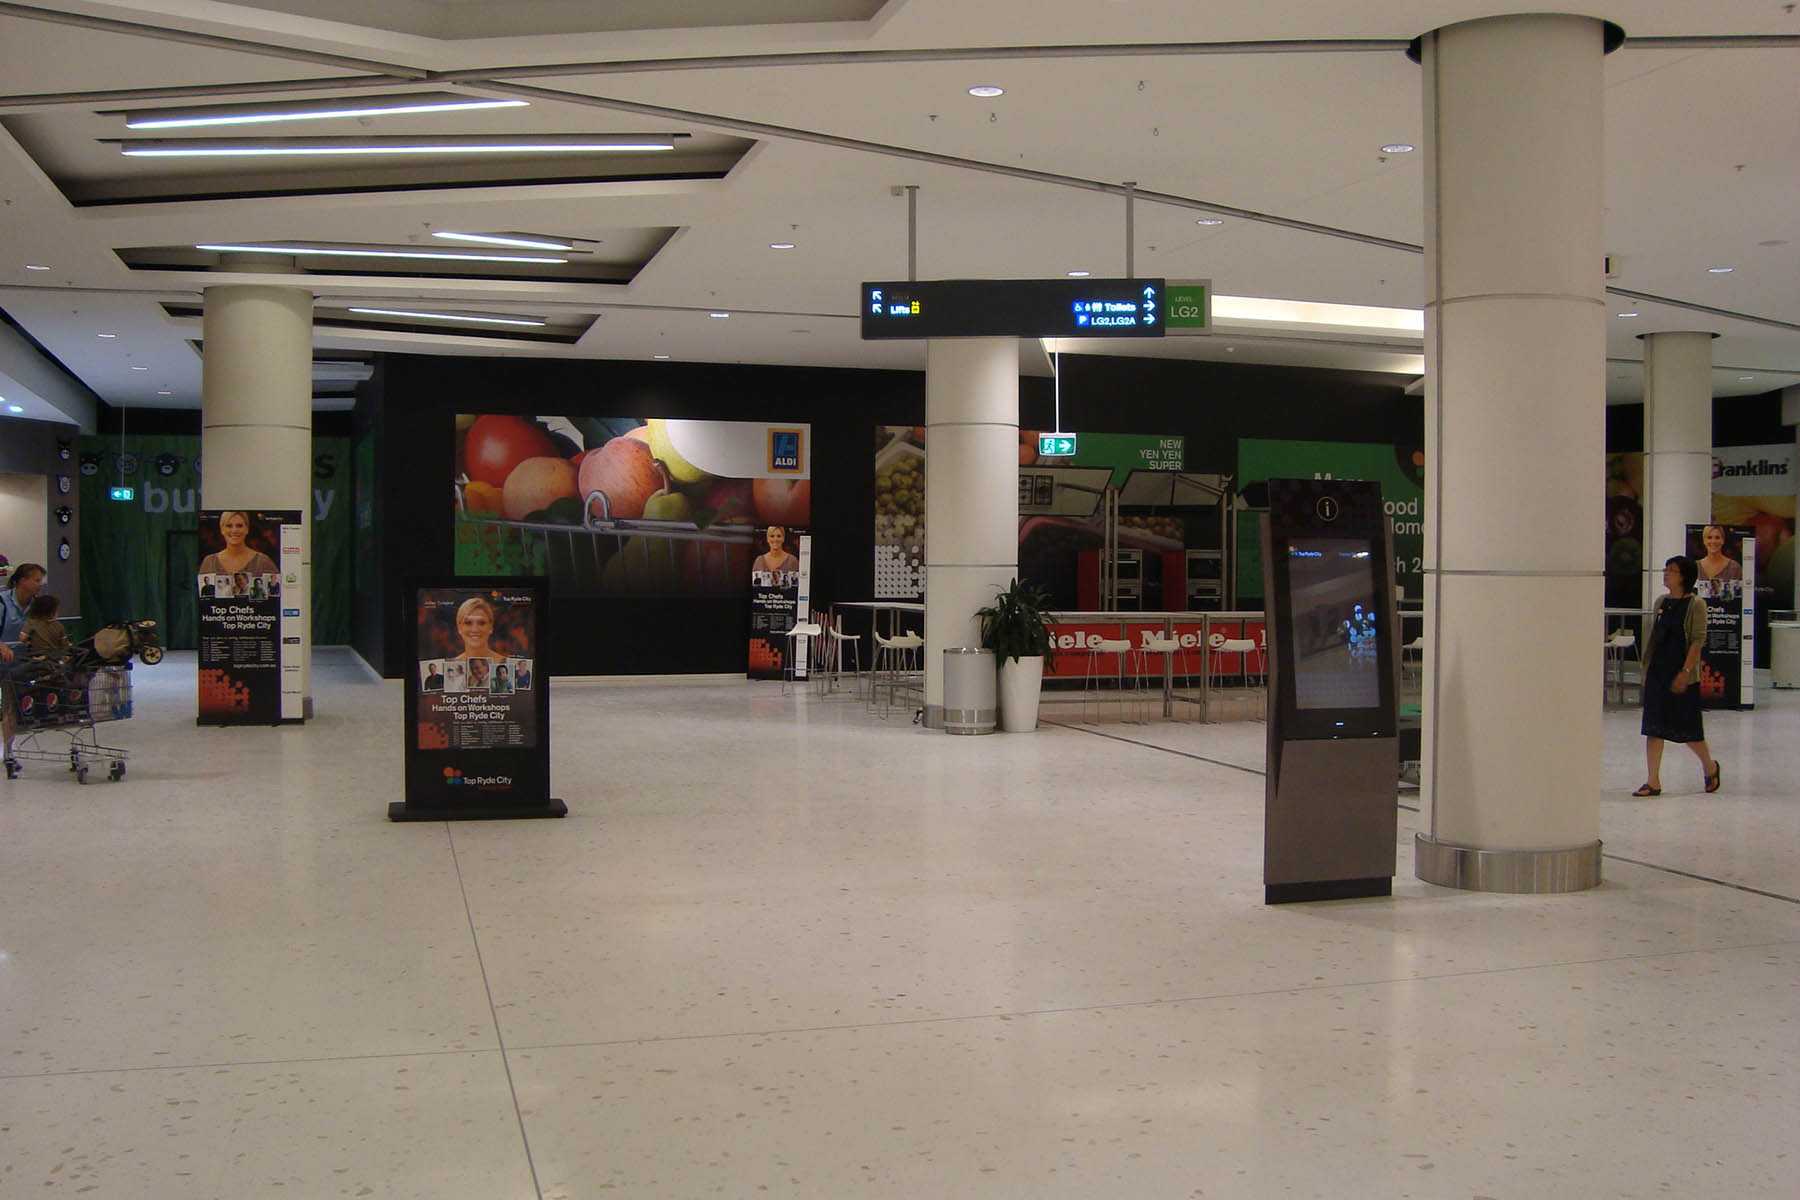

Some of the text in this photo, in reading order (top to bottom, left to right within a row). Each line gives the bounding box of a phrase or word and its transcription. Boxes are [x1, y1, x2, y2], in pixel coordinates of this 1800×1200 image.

[890, 305, 910, 315] Lifts
[1104, 303, 1136, 312] Toilets
[1170, 305, 1199, 318] LG2
[1160, 439, 1182, 449] NEW
[1139, 449, 1182, 460] YEN YEN
[775, 457, 797, 466] ALDI
[1149, 460, 1182, 471] SUPER
[1382, 497, 1418, 516] ood
[1391, 517, 1424, 535] om
[211, 605, 255, 615] Top Chefs
[236, 614, 276, 622] Workshops
[223, 622, 272, 630] Top Ryde City
[1048, 631, 1104, 648] iele
[441, 695, 458, 704] Top
[460, 694, 487, 704] Chefs
[432, 704, 456, 712] Hands
[468, 704, 510, 712] Workshops
[453, 711, 505, 720] Top Ryde City
[463, 776, 512, 785] Top Ryde City
